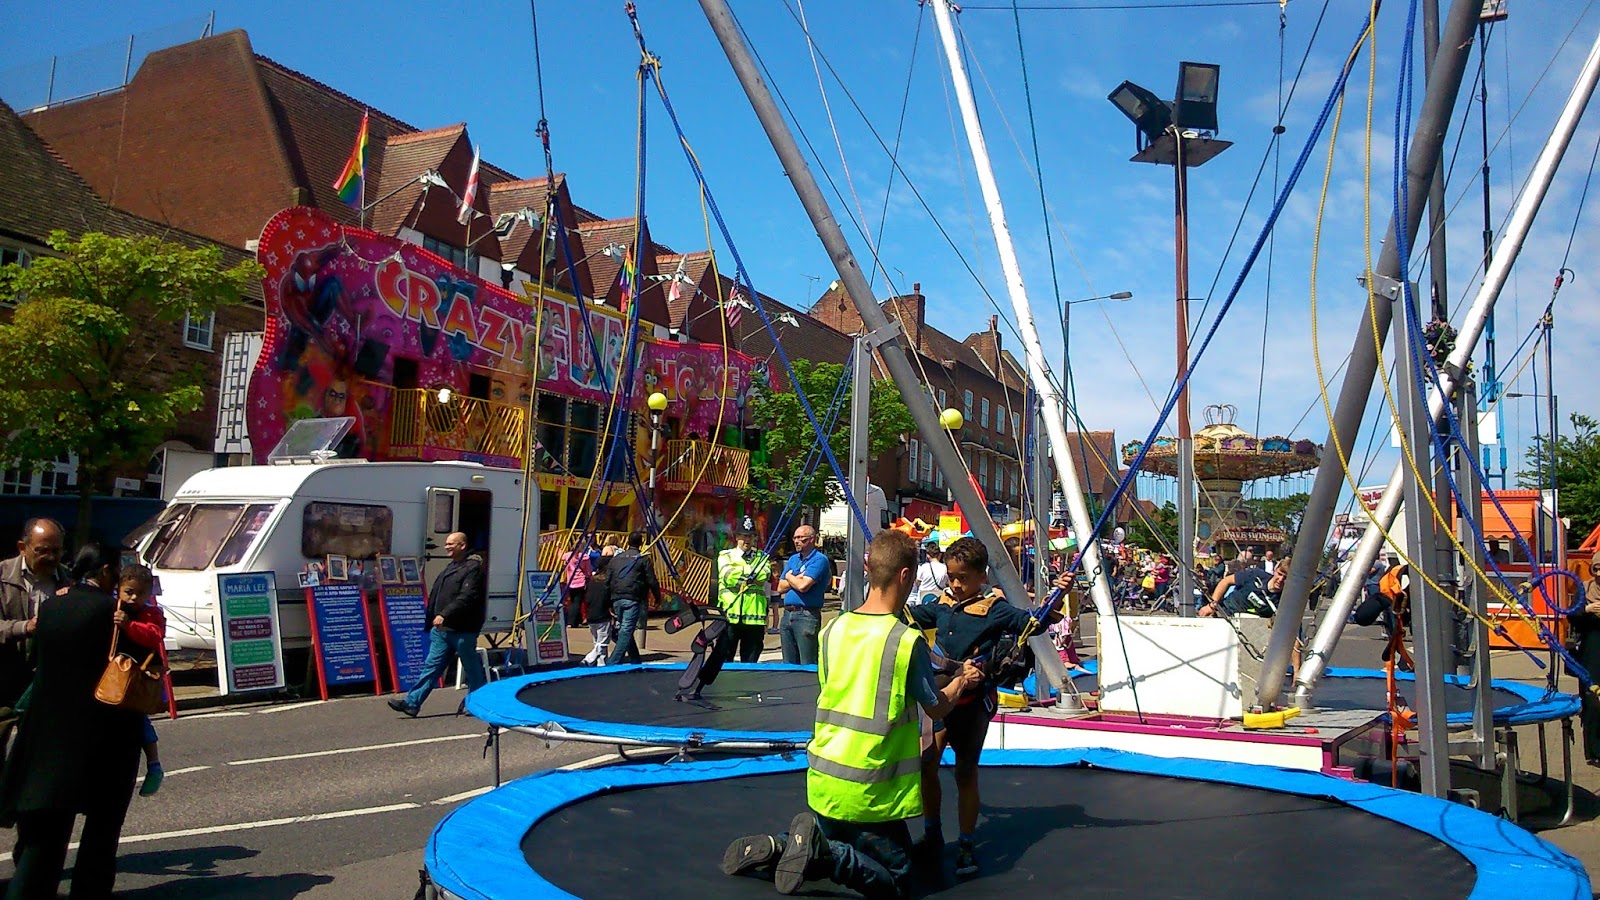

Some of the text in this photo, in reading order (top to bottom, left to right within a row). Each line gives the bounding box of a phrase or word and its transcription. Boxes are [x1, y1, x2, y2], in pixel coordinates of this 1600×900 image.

[375, 258, 537, 364] CRAZY
[533, 292, 645, 397] FUN
[1223, 531, 1285, 540] WAVE SWINGER
[227, 583, 266, 593] MARIA LEE
